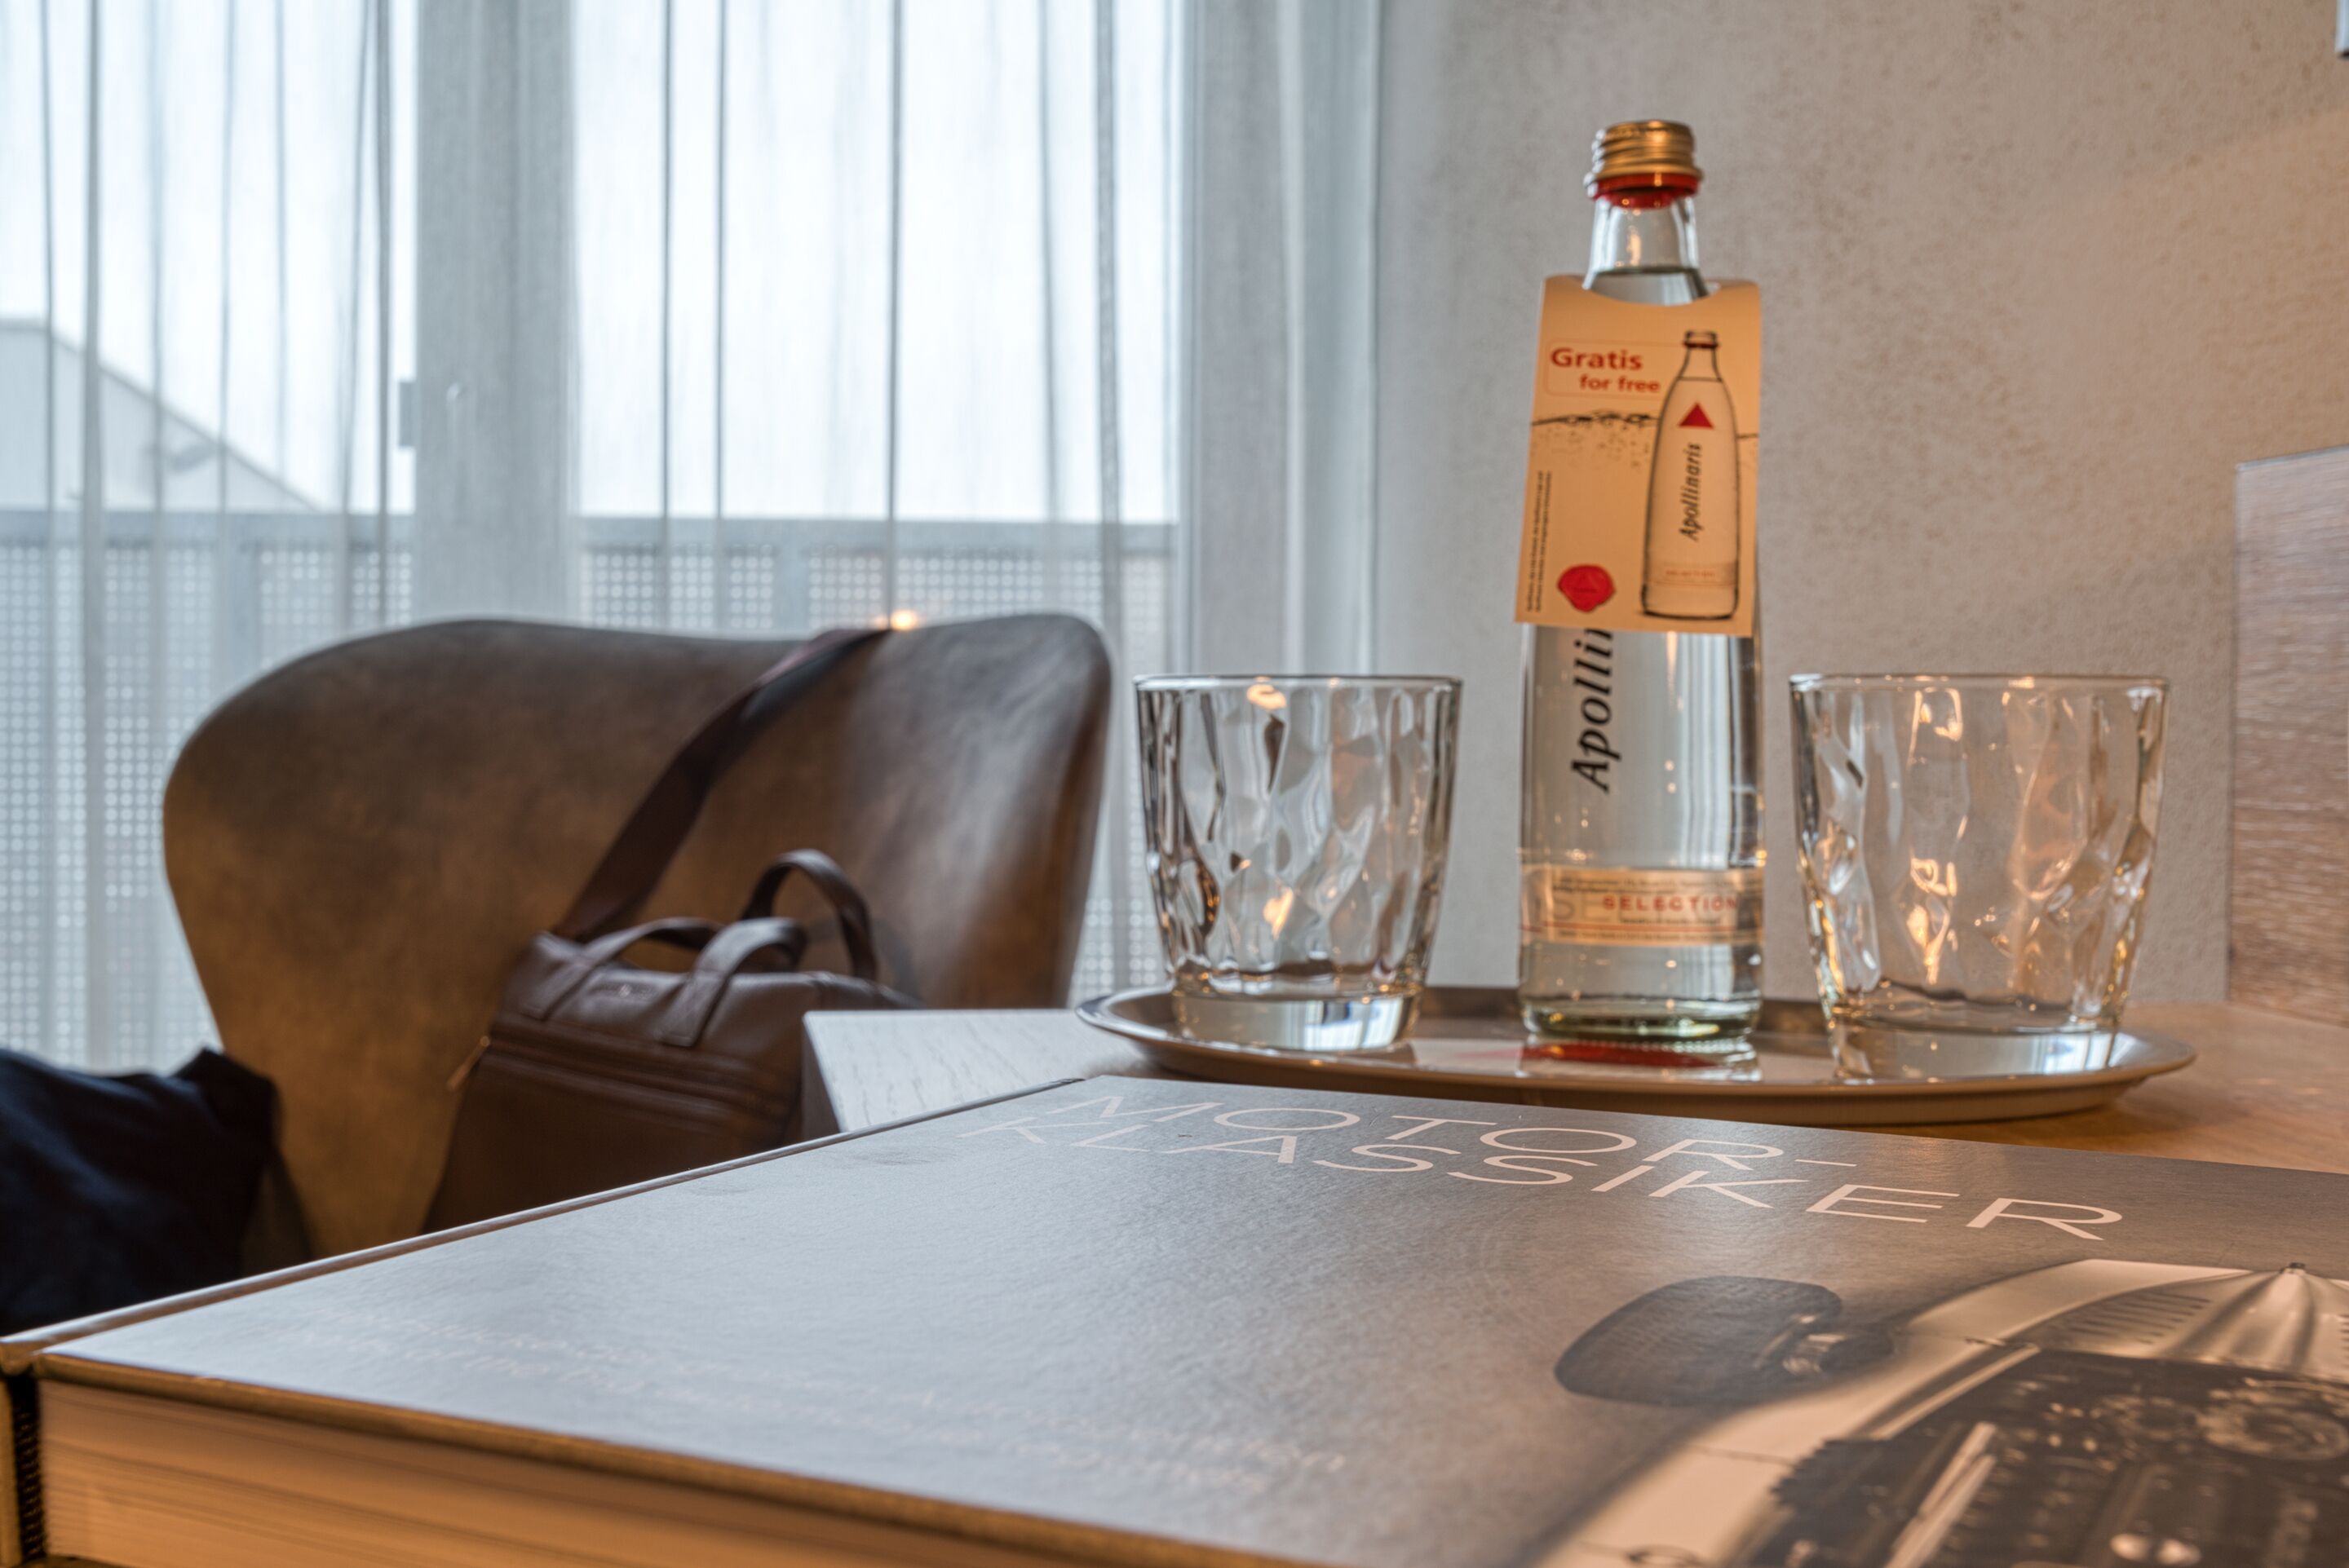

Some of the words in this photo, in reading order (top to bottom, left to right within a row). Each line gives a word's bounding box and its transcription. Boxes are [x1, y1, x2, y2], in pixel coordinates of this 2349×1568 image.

[1551, 347, 1643, 370] Gratis
[1579, 373, 1611, 390] for
[1618, 375, 1661, 392] free
[1679, 442, 1705, 542] Apollinaris
[1603, 894, 1738, 912] SELECTION
[1046, 1095, 1857, 1172] MOTOR-
[956, 1116, 2123, 1242] KLASSIKER
